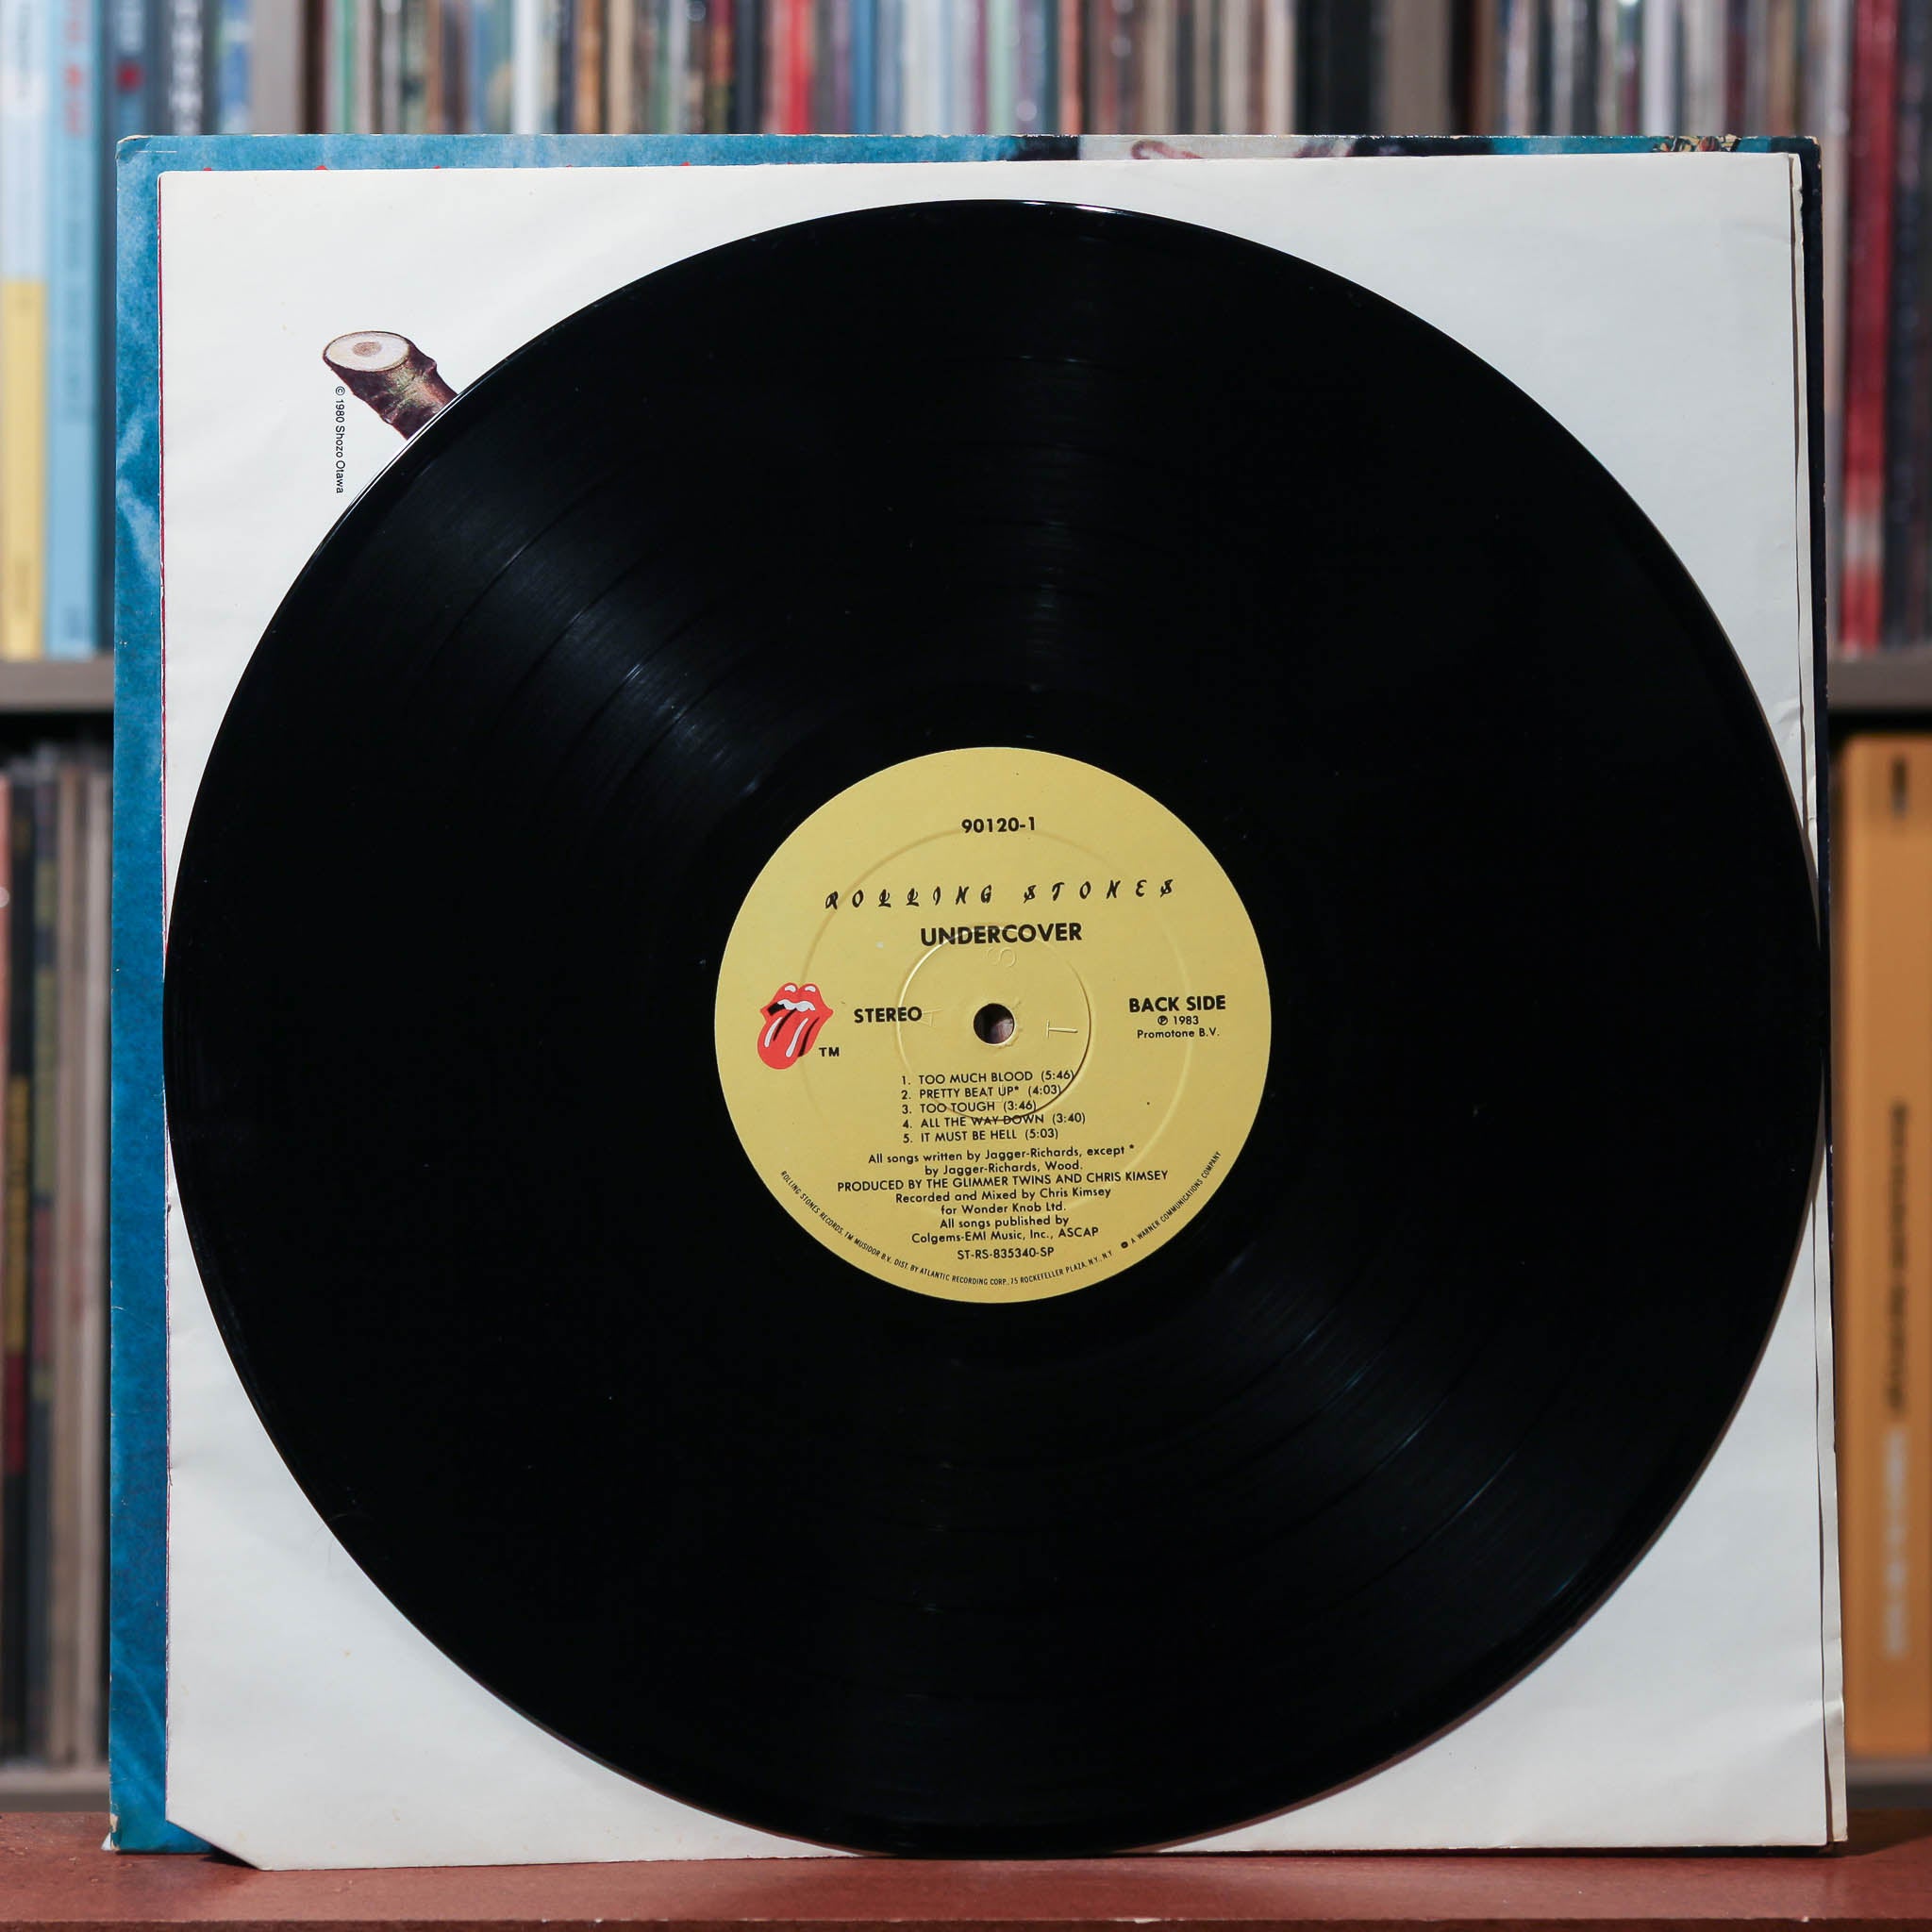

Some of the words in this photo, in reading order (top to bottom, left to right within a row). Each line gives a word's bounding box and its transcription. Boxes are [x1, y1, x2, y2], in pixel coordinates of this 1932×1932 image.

[336, 399, 345, 423] 1980
[335, 425, 345, 458] Shozo
[336, 459, 345, 494] Otawa
[961, 817, 1036, 833] 90120-1
[825, 885, 992, 910] ROLLING
[1024, 879, 1174, 903] STONES
[921, 923, 1082, 946] UNDERCOVER
[1129, 997, 1179, 1012] BACK
[1186, 995, 1225, 1011] SIDE
[854, 1007, 923, 1024] STEREO
[1174, 1016, 1199, 1025] 1983
[1137, 1029, 1195, 1039] Promotone
[1199, 1027, 1220, 1037] B.V.
[819, 1047, 840, 1057] TM
[902, 1075, 910, 1085] 1.
[919, 1074, 945, 1084] TOO
[950, 1073, 987, 1083] MUCH
[991, 1072, 1033, 1082] BLOOD
[1041, 1070, 1074, 1082] (5:46)
[901, 1091, 911, 1100] 2.
[920, 1088, 960, 1099] PRETTY
[965, 1087, 993, 1097] BEAT
[1027, 1085, 1061, 1097] (4:03)
[902, 1105, 911, 1114] 3.
[920, 1103, 947, 1113] TOO
[951, 1101, 995, 1112] TOUGH
[1003, 1100, 1037, 1112] (3:46)
[903, 1120, 912, 1129] 4.
[921, 1118, 940, 1128] ALL
[944, 1116, 966, 1126] THE
[971, 1115, 999, 1125] WAY
[1003, 1114, 1044, 1125] DOWN
[1052, 1112, 1086, 1124] (3:40)
[903, 1134, 913, 1143] 5.
[921, 1132, 930, 1142] IT
[935, 1131, 968, 1141] MUST
[973, 1130, 986, 1141] BE
[991, 1129, 1017, 1140] HELL
[1024, 1127, 1058, 1140] (5:03)
[868, 1153, 883, 1163] All
[887, 1155, 919, 1164] songs
[923, 1151, 962, 1161] written
[967, 1150, 981, 1161] by
[985, 1146, 1082, 1161] Jagger-Richards,
[1087, 1146, 1124, 1158] except
[925, 1165, 939, 1176] by
[943, 1161, 1041, 1176] Jagger-Richards,
[1045, 1160, 1083, 1171] Wood.
[838, 1180, 904, 1191] PRODUCED
[908, 1179, 922, 1190] BY
[926, 1178, 948, 1189] THE
[953, 1176, 1008, 1188] GLIMMER
[1012, 1174, 1051, 1186] TWINS
[1056, 1174, 1082, 1184] AND
[1087, 1172, 1122, 1183] CHRIS
[1125, 1170, 1168, 1181] KIMSEY
[896, 1191, 950, 1203] Recorded
[955, 1191, 977, 1201] and
[981, 1189, 1017, 1200] Mixed
[1022, 1189, 1036, 1200] by
[1040, 1187, 1069, 1198] Chris
[1073, 1187, 1111, 1198] Kimsey
[1137, 1220, 1160, 1240] WARNER
[1160, 1178, 1204, 1223] COMMUNICATIONS
[1201, 1151, 1222, 1178] COMPANY
[941, 1206, 958, 1215] for
[961, 1203, 1008, 1214] Wonder
[1012, 1202, 1041, 1212] Knob
[1045, 1201, 1066, 1211] Ltd.
[780, 1170, 802, 1194] ROLLING
[800, 1193, 821, 1214] STONES
[854, 1238, 881, 1257] MUSIDOR
[910, 1264, 919, 1273] BY
[920, 1267, 950, 1281] ATLANTIC
[952, 1274, 988, 1286] RECORDING
[1020, 1268, 1063, 1284] ROCKEFELLER
[940, 1218, 955, 1228] All
[958, 1220, 991, 1229] songs
[995, 1215, 1051, 1229] published
[1056, 1214, 1069, 1225] by
[911, 1231, 987, 1244] Colgems-EMI
[991, 1230, 1025, 1241] Music,
[1030, 1228, 1054, 1240] Inc.,
[1058, 1227, 1099, 1238] ASCAP
[957, 1246, 1055, 1260] ST-RS-835340-SP
